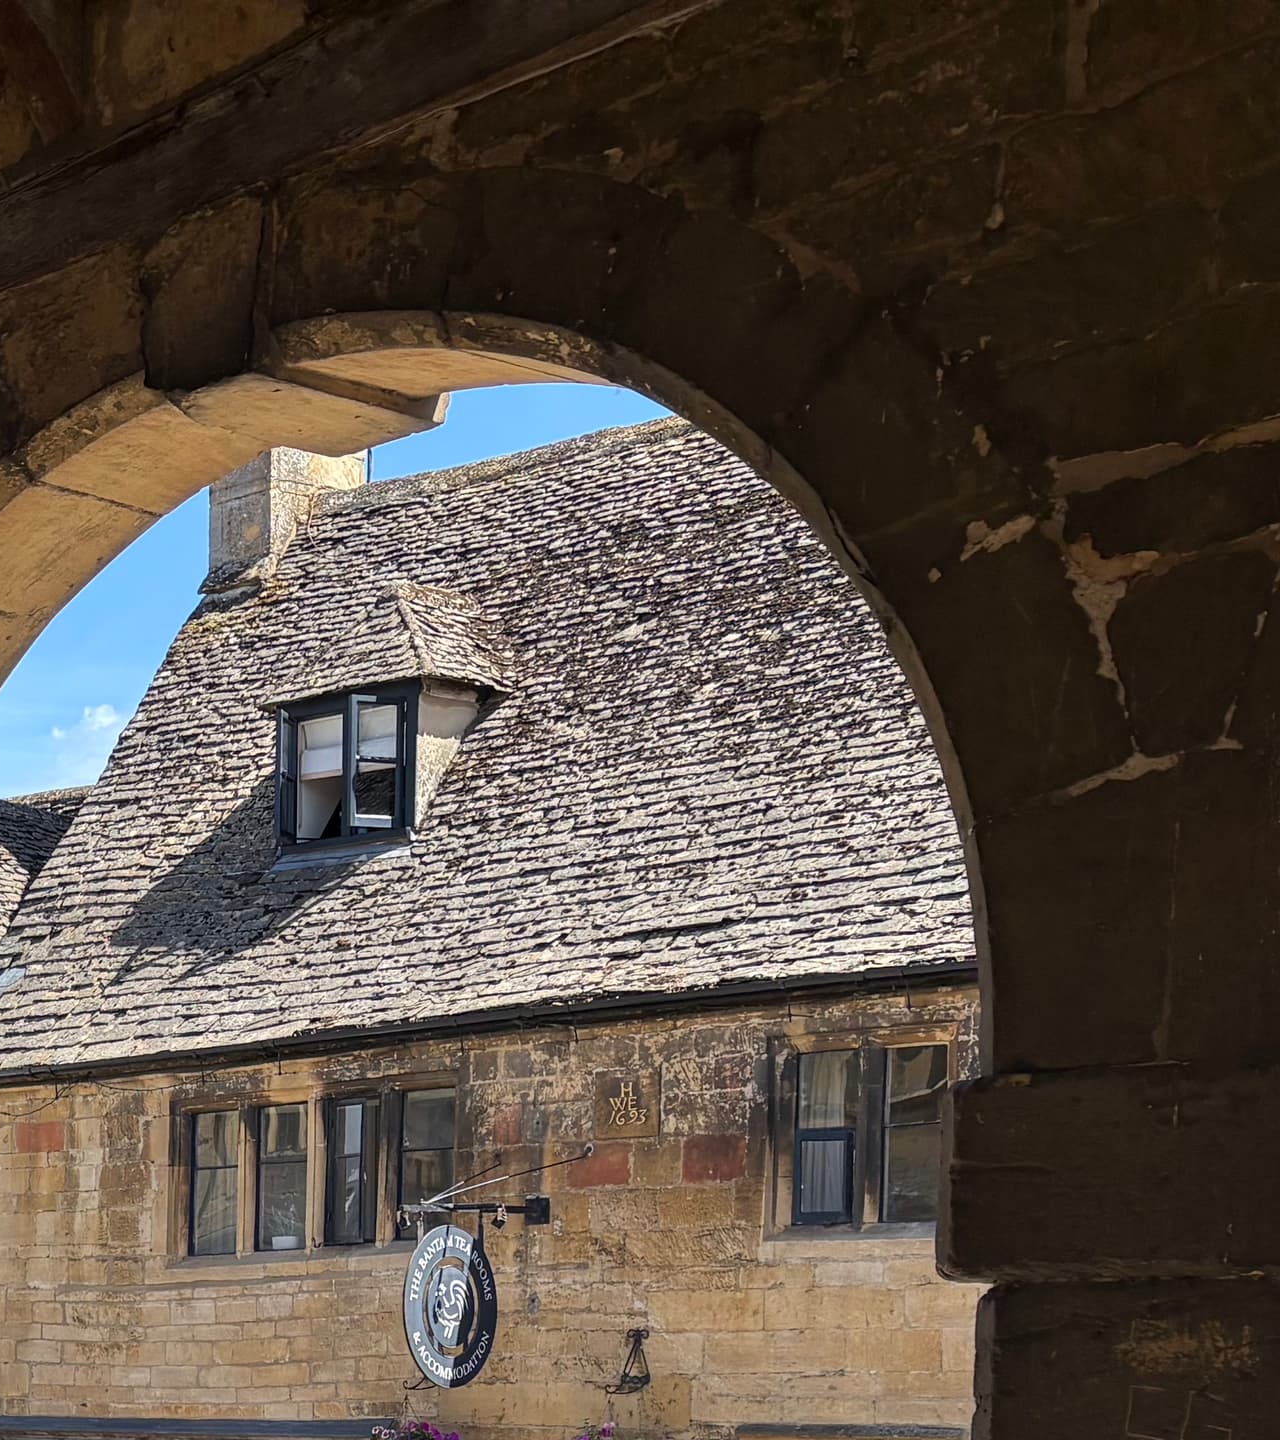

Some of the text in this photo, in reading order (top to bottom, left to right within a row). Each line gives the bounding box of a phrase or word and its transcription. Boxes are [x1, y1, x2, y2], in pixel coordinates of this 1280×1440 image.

[410, 1233, 493, 1302] THE BANTAM TEA ROOMS
[413, 1330, 491, 1381] & ACCOMMODATION
